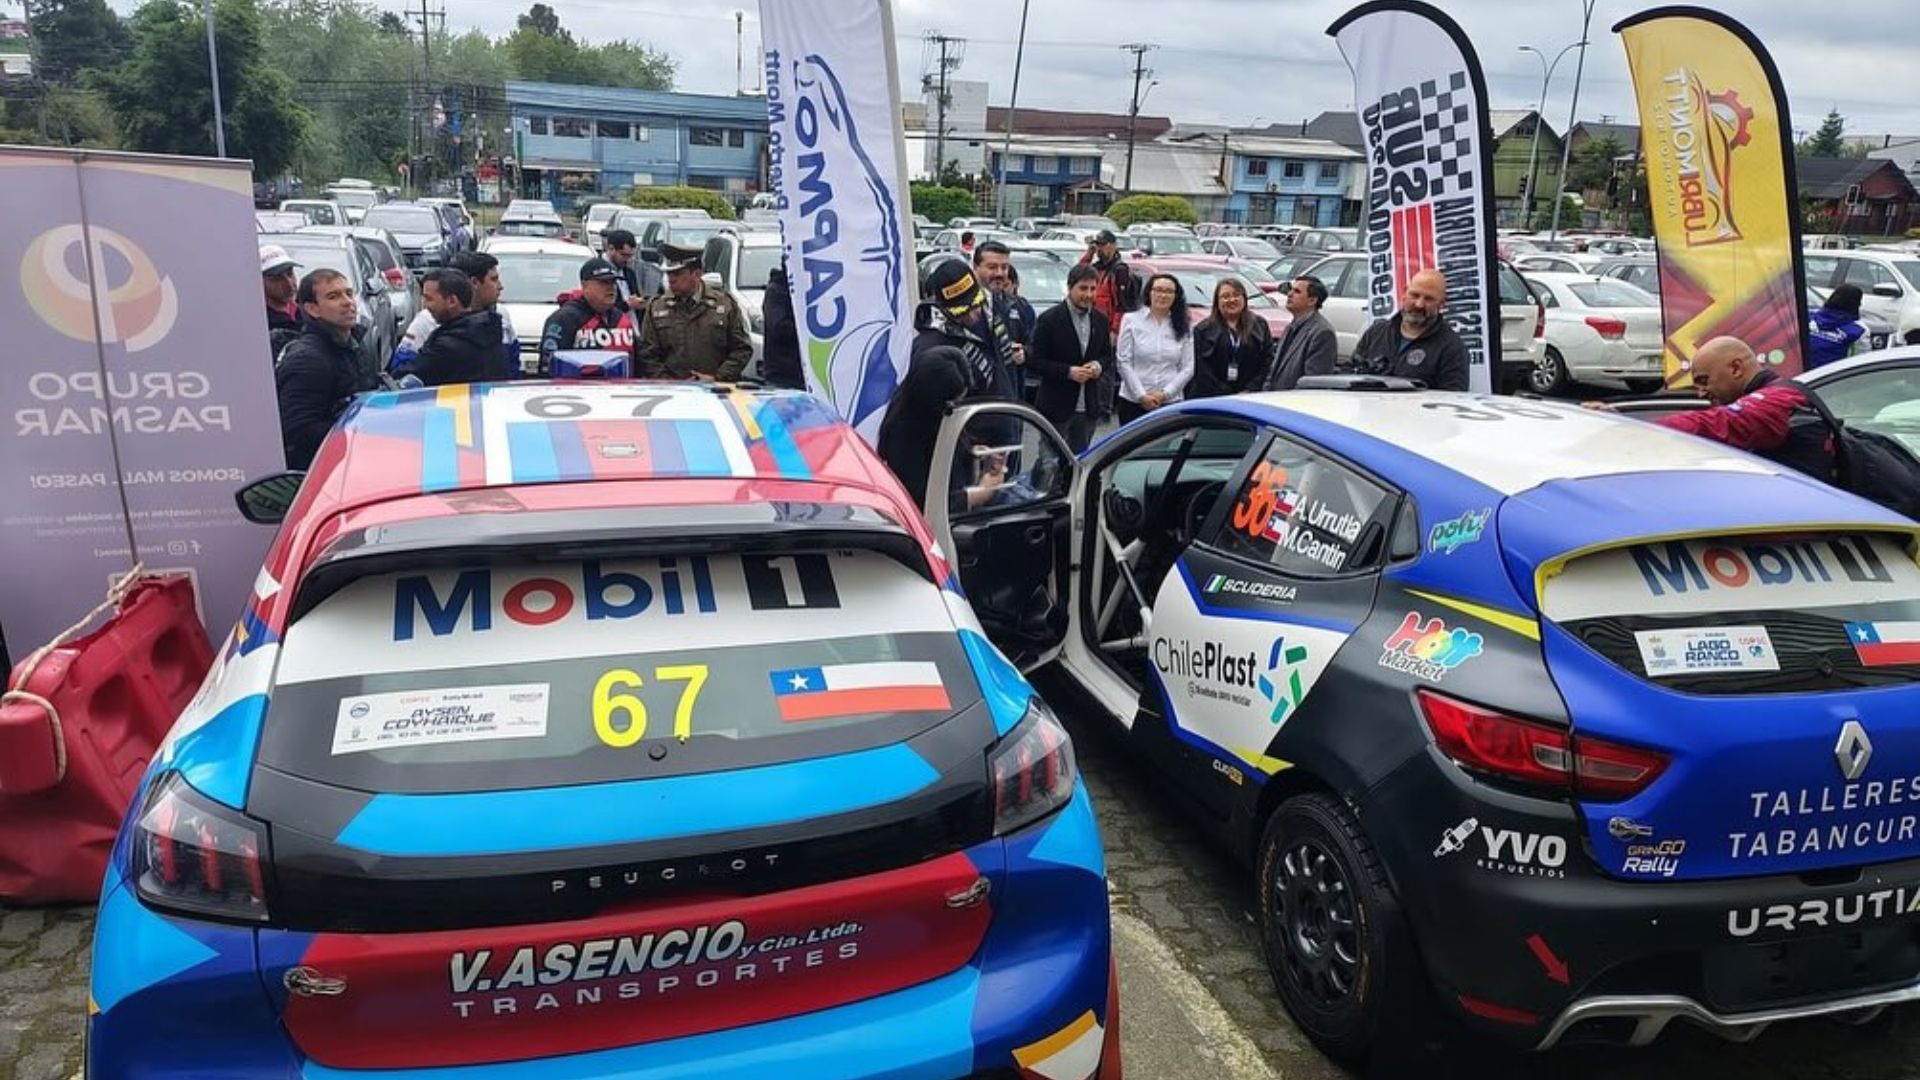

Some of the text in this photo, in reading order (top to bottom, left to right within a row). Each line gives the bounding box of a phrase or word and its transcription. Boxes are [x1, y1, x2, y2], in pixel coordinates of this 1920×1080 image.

[524, 394, 673, 418] 67
[1629, 541, 1833, 597] Mobil
[393, 554, 718, 641] Mobil
[1222, 578, 1298, 601] SCUDERIA
[1152, 637, 1257, 689] ChilePlast
[1685, 650, 1739, 662] RANCO
[1687, 640, 1731, 651] LAGO
[382, 712, 496, 731] COYHAIQUE
[592, 664, 709, 748] 67
[1750, 775, 1920, 818] TALLERES
[1479, 824, 1567, 867] YVO
[1729, 815, 1917, 859] TABANCUR
[552, 855, 779, 892] PEUGOT
[1476, 857, 1565, 879] REPUESTOS
[1622, 856, 1679, 877] Rally
[453, 943, 860, 1018] TRANSPORTES
